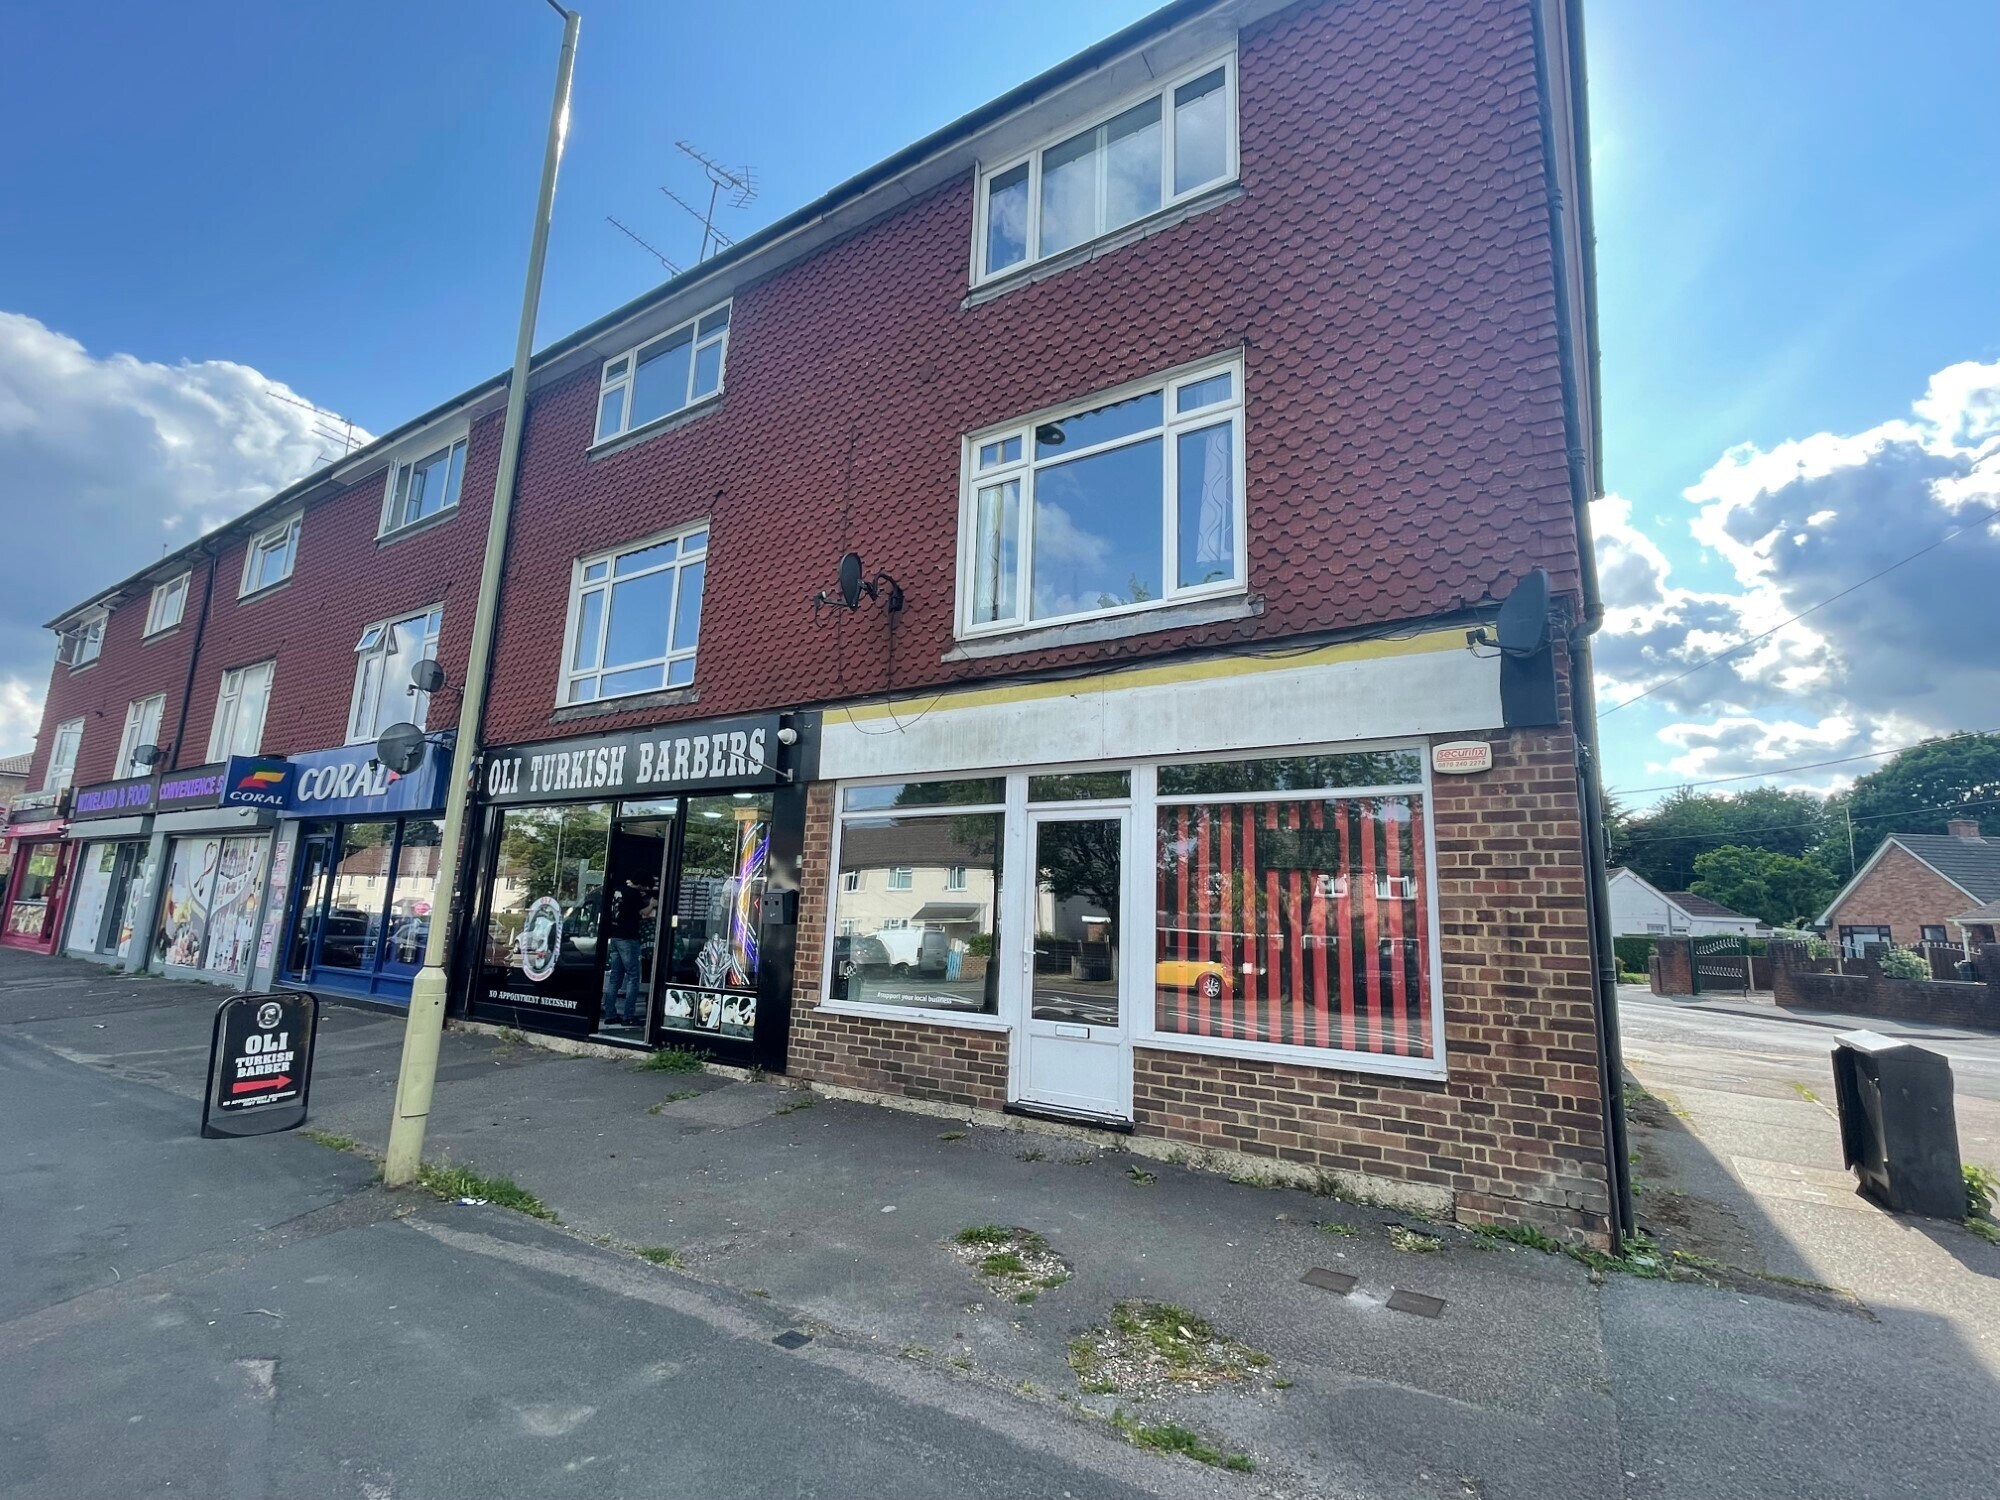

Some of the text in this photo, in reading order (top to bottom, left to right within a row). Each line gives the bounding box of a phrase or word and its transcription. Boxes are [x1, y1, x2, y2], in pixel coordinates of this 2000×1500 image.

[488, 727, 766, 797] OLI TURKISH BARBERS
[159, 778, 215, 800] CONVENIENCE
[297, 763, 388, 802] CORAL
[229, 791, 284, 805] CORAL
[541, 997, 577, 1009] NECESSARY
[245, 1032, 288, 1055] OLI
[235, 1051, 294, 1068] TURKISH
[237, 1062, 290, 1078] BARBER
